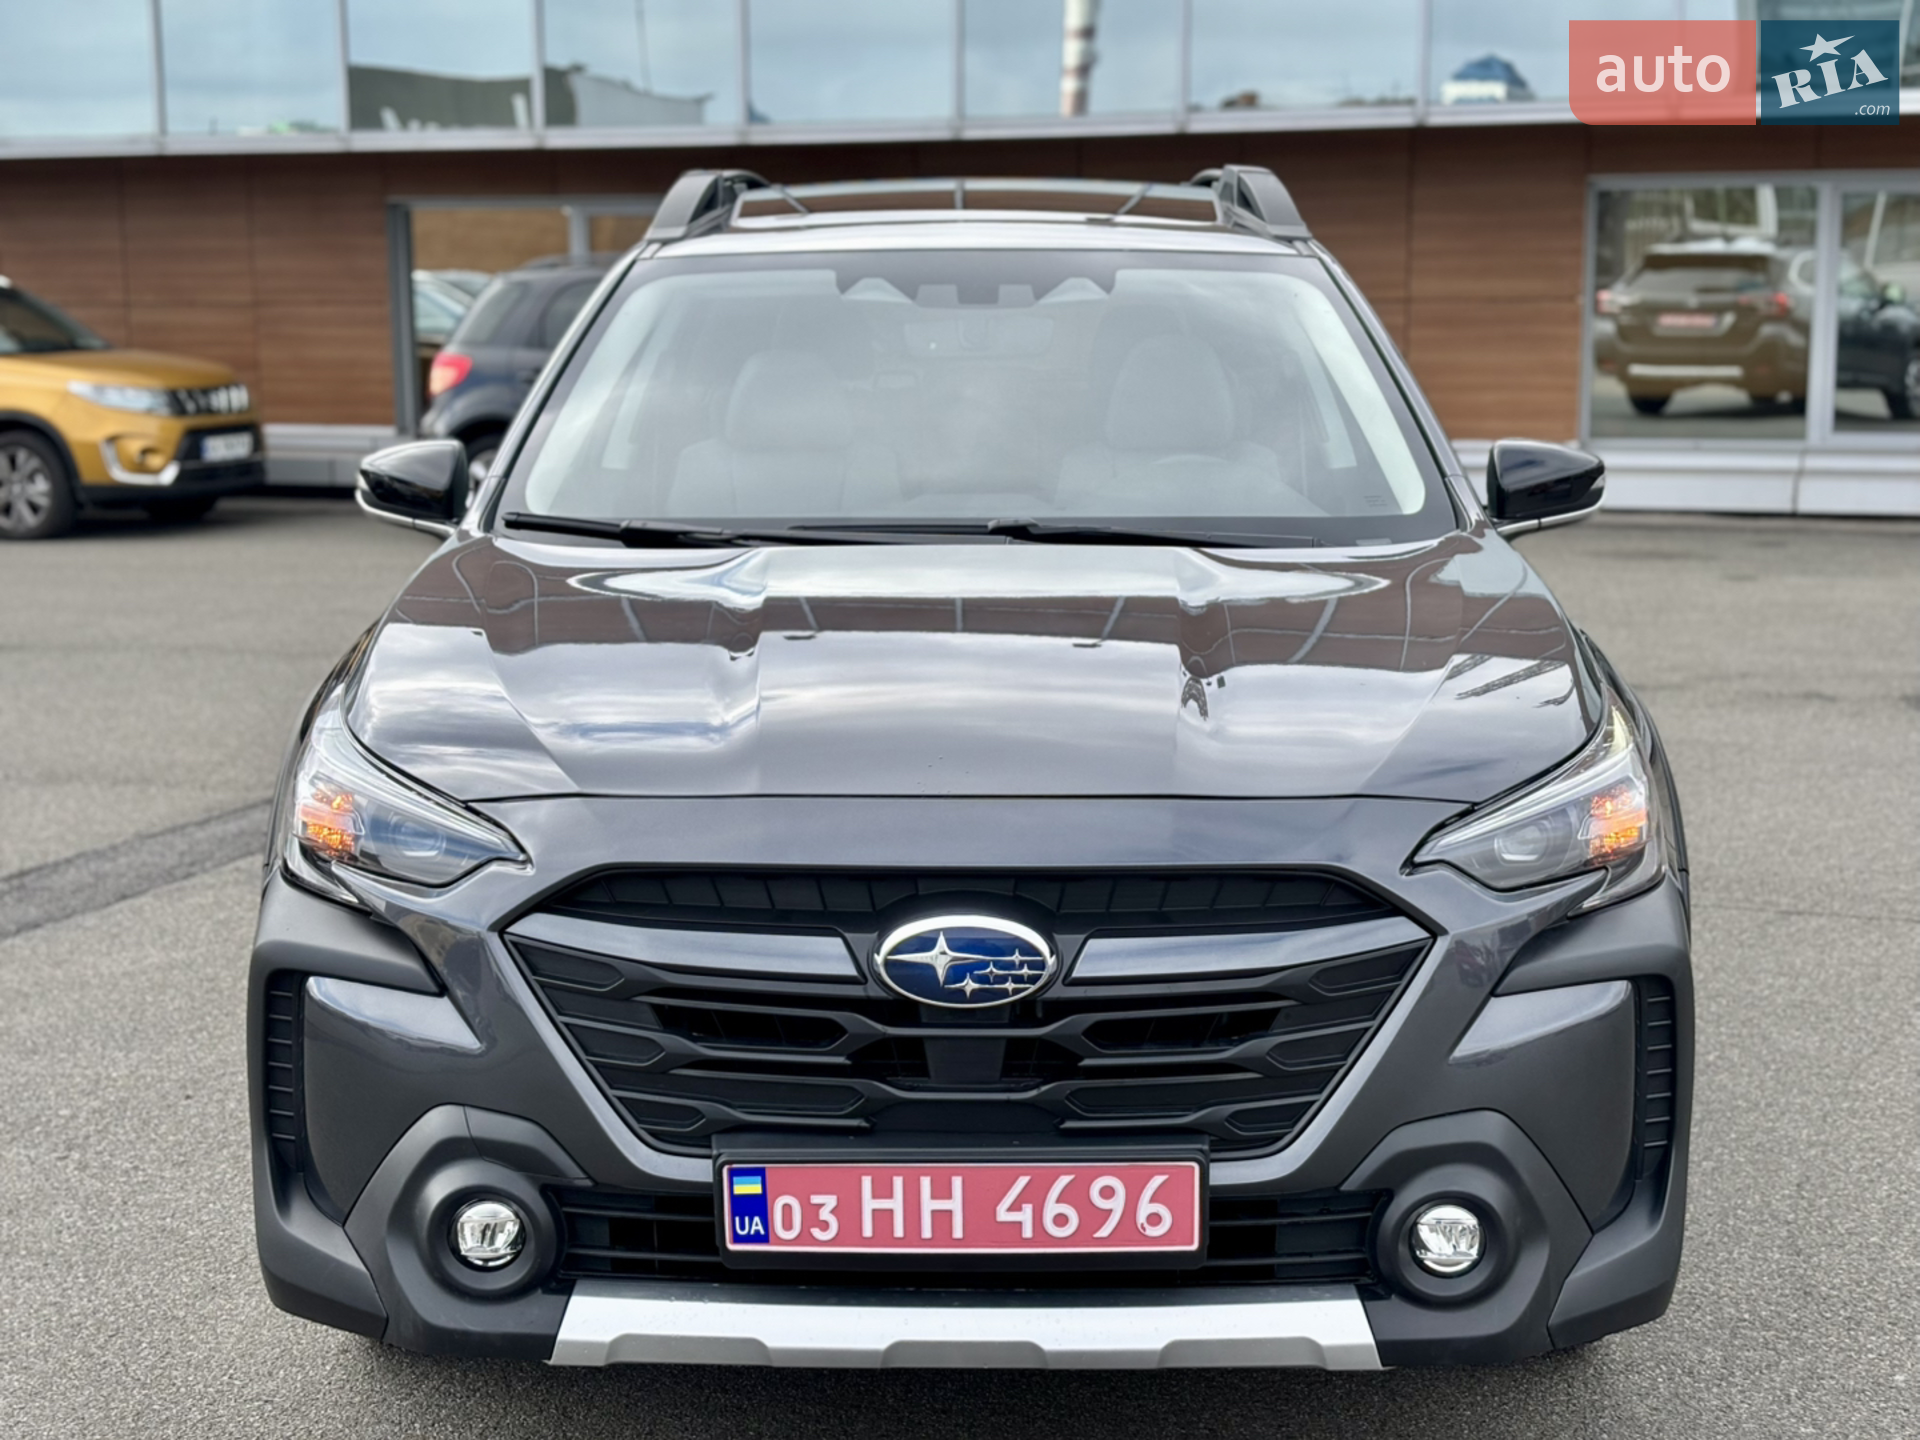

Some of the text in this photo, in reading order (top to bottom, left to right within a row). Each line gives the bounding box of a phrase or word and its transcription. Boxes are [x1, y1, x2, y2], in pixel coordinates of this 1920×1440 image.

[735, 1174, 1174, 1241] UA 03 HH 4696
